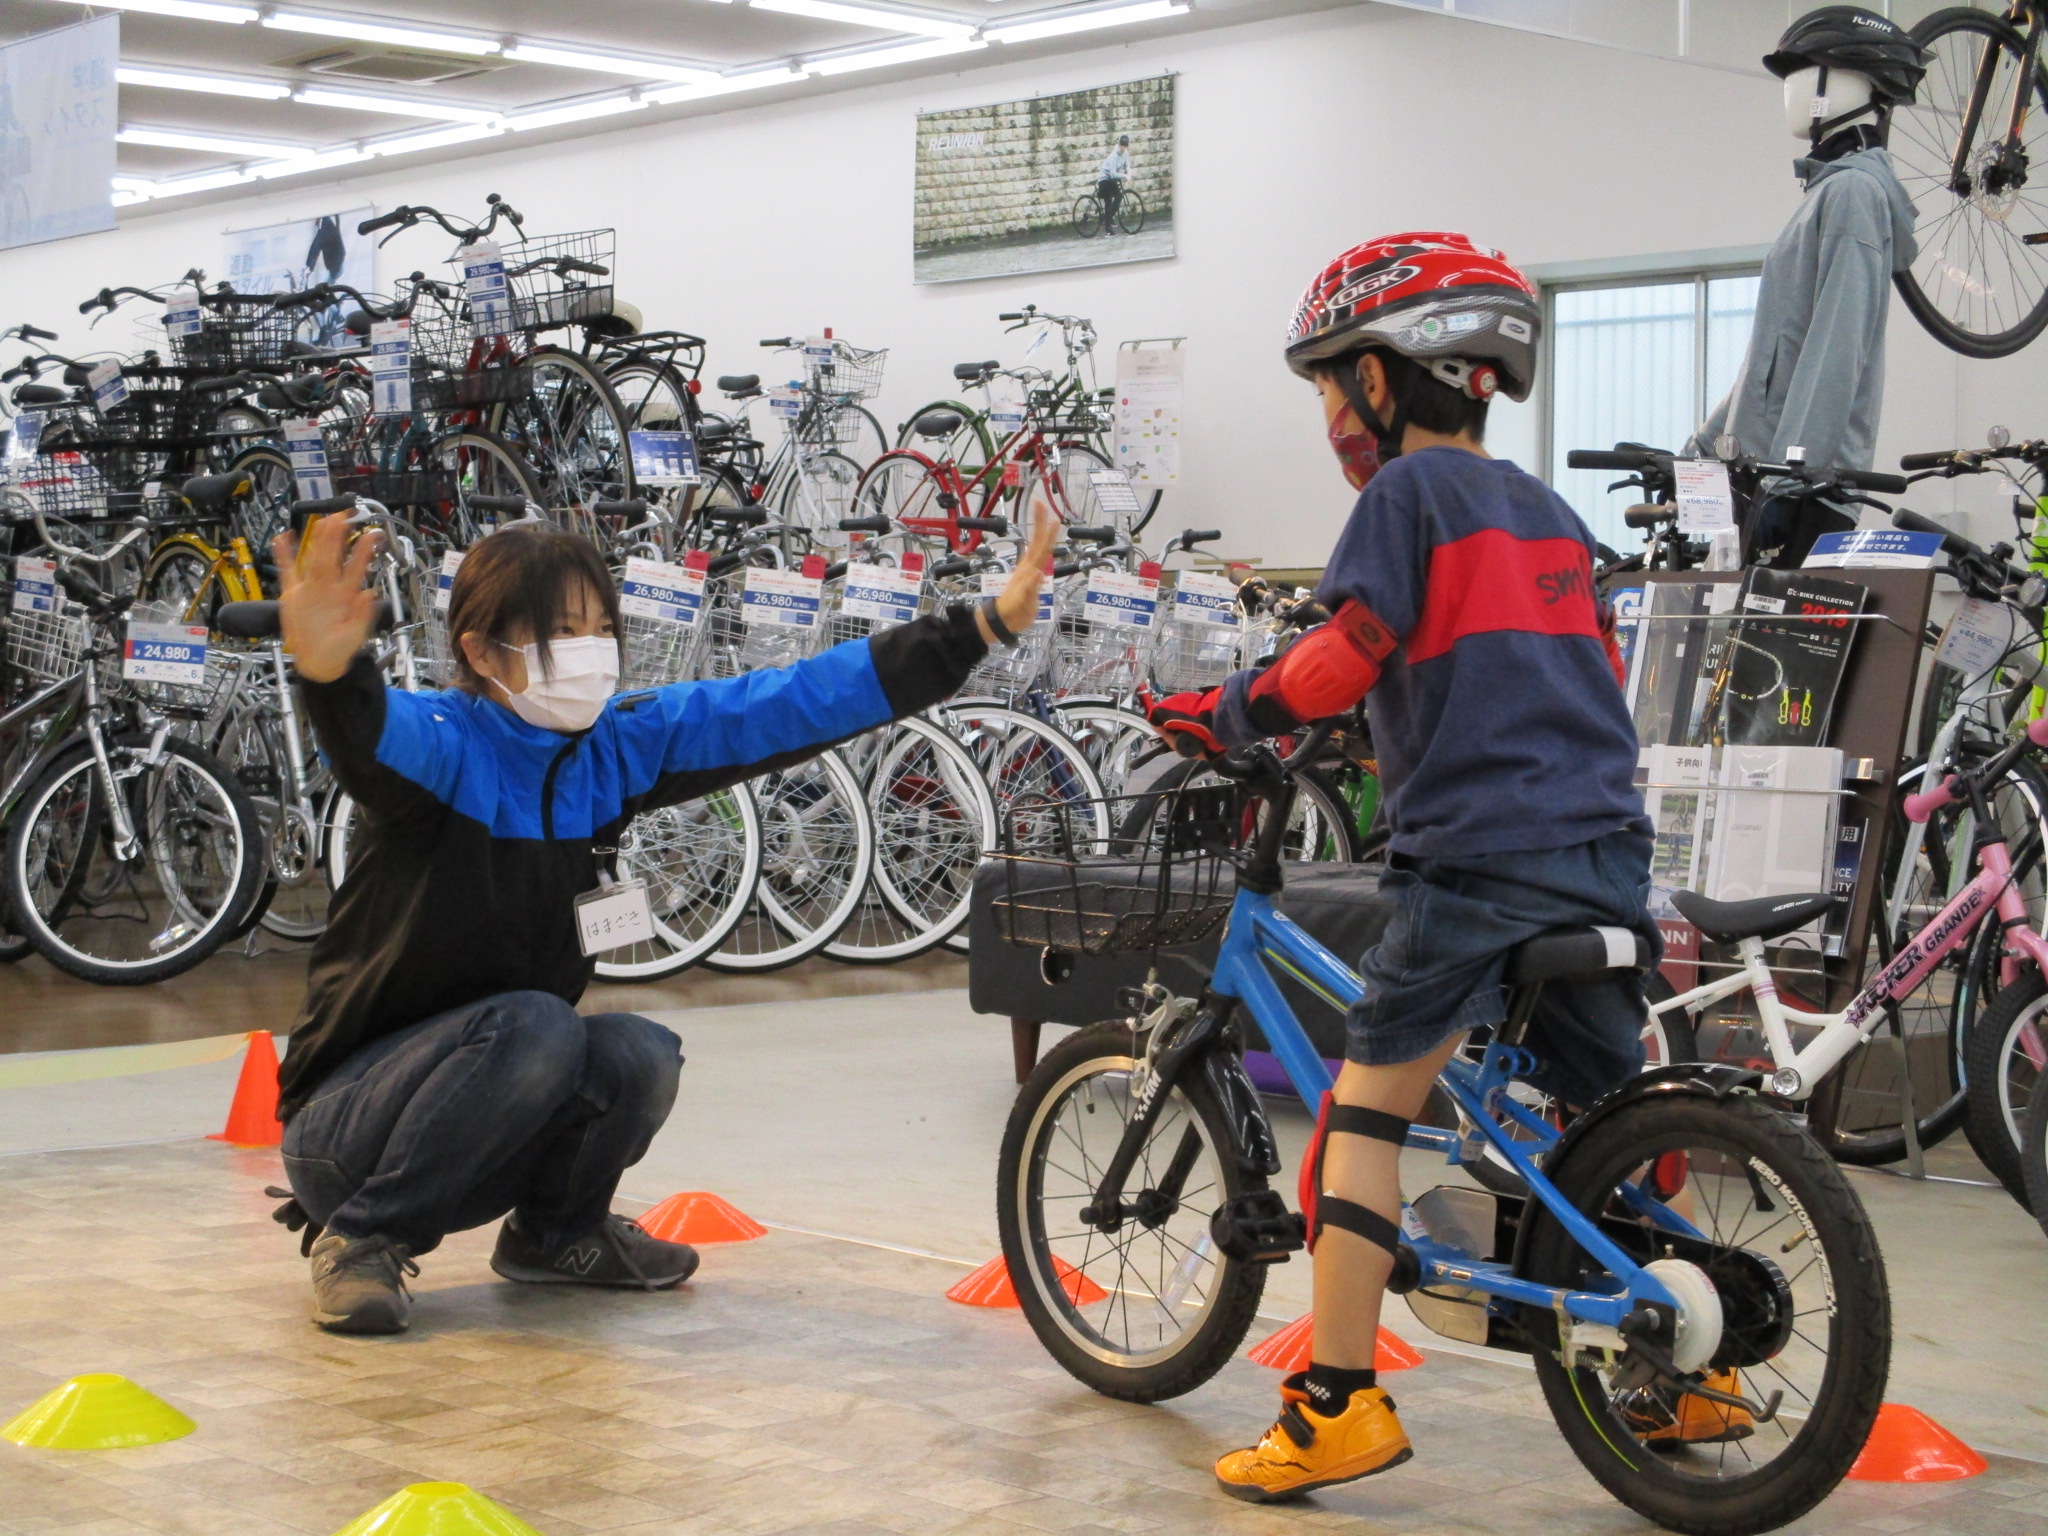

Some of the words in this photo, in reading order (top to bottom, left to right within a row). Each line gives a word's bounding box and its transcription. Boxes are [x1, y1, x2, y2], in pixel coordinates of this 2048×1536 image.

[928, 133, 984, 152] REUNION
[1338, 269, 1402, 304] OGK
[1815, 593, 1854, 606] COLLECTION
[1801, 603, 1849, 628] 2019
[1854, 943, 1926, 1019] KICKER
[1924, 893, 1981, 952] GRANDE
[1749, 1156, 1782, 1186] HERO
[1778, 1184, 1818, 1239] MOTORS
